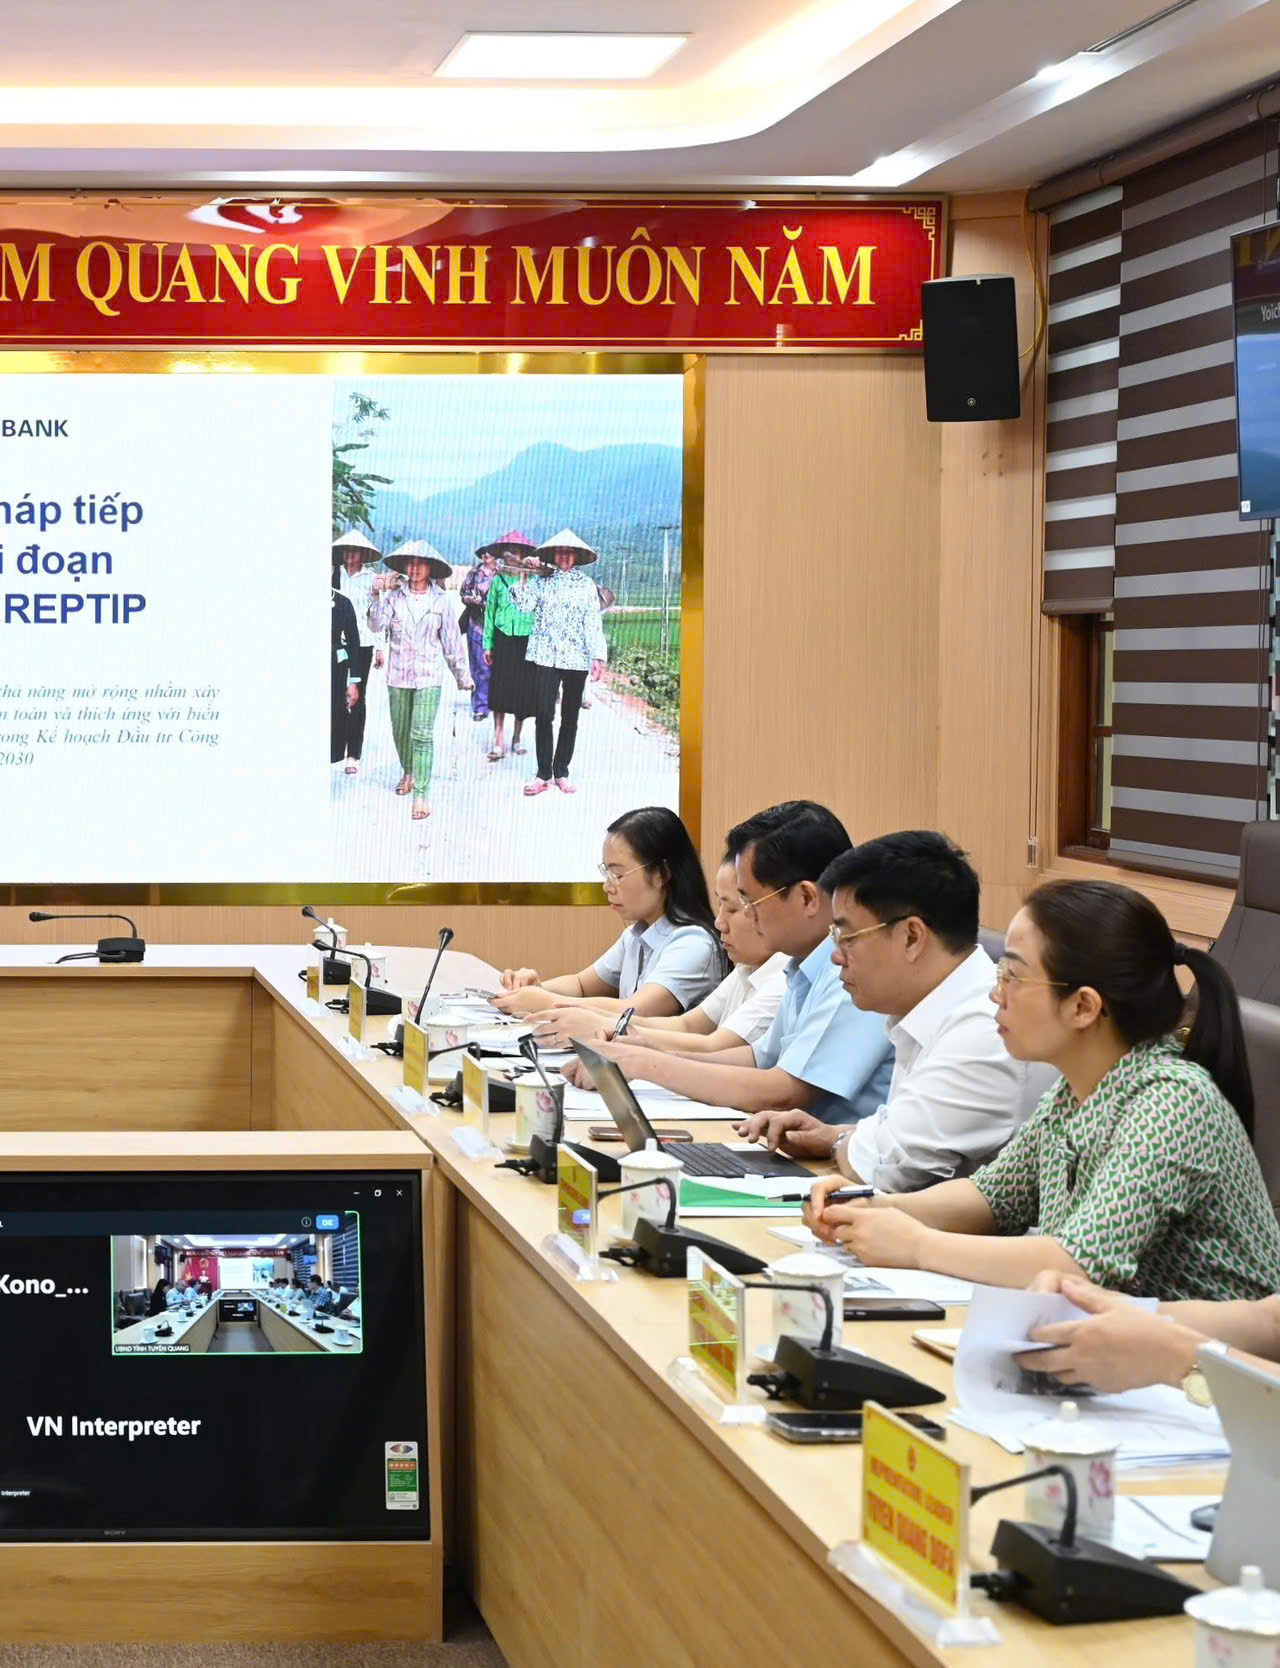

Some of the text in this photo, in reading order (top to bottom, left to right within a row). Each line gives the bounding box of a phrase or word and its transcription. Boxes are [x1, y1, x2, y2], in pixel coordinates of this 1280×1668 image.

[76, 242, 303, 316] QUANG
[321, 245, 492, 304] VINH
[511, 226, 701, 306] MUÔN
[725, 225, 877, 306] NĂM
[1, 418, 69, 437] BANK
[73, 491, 144, 532] tiếp
[16, 543, 113, 582] đoạn
[4, 593, 147, 624] REPTIP
[26, 1415, 201, 1441] VN Interpreter
